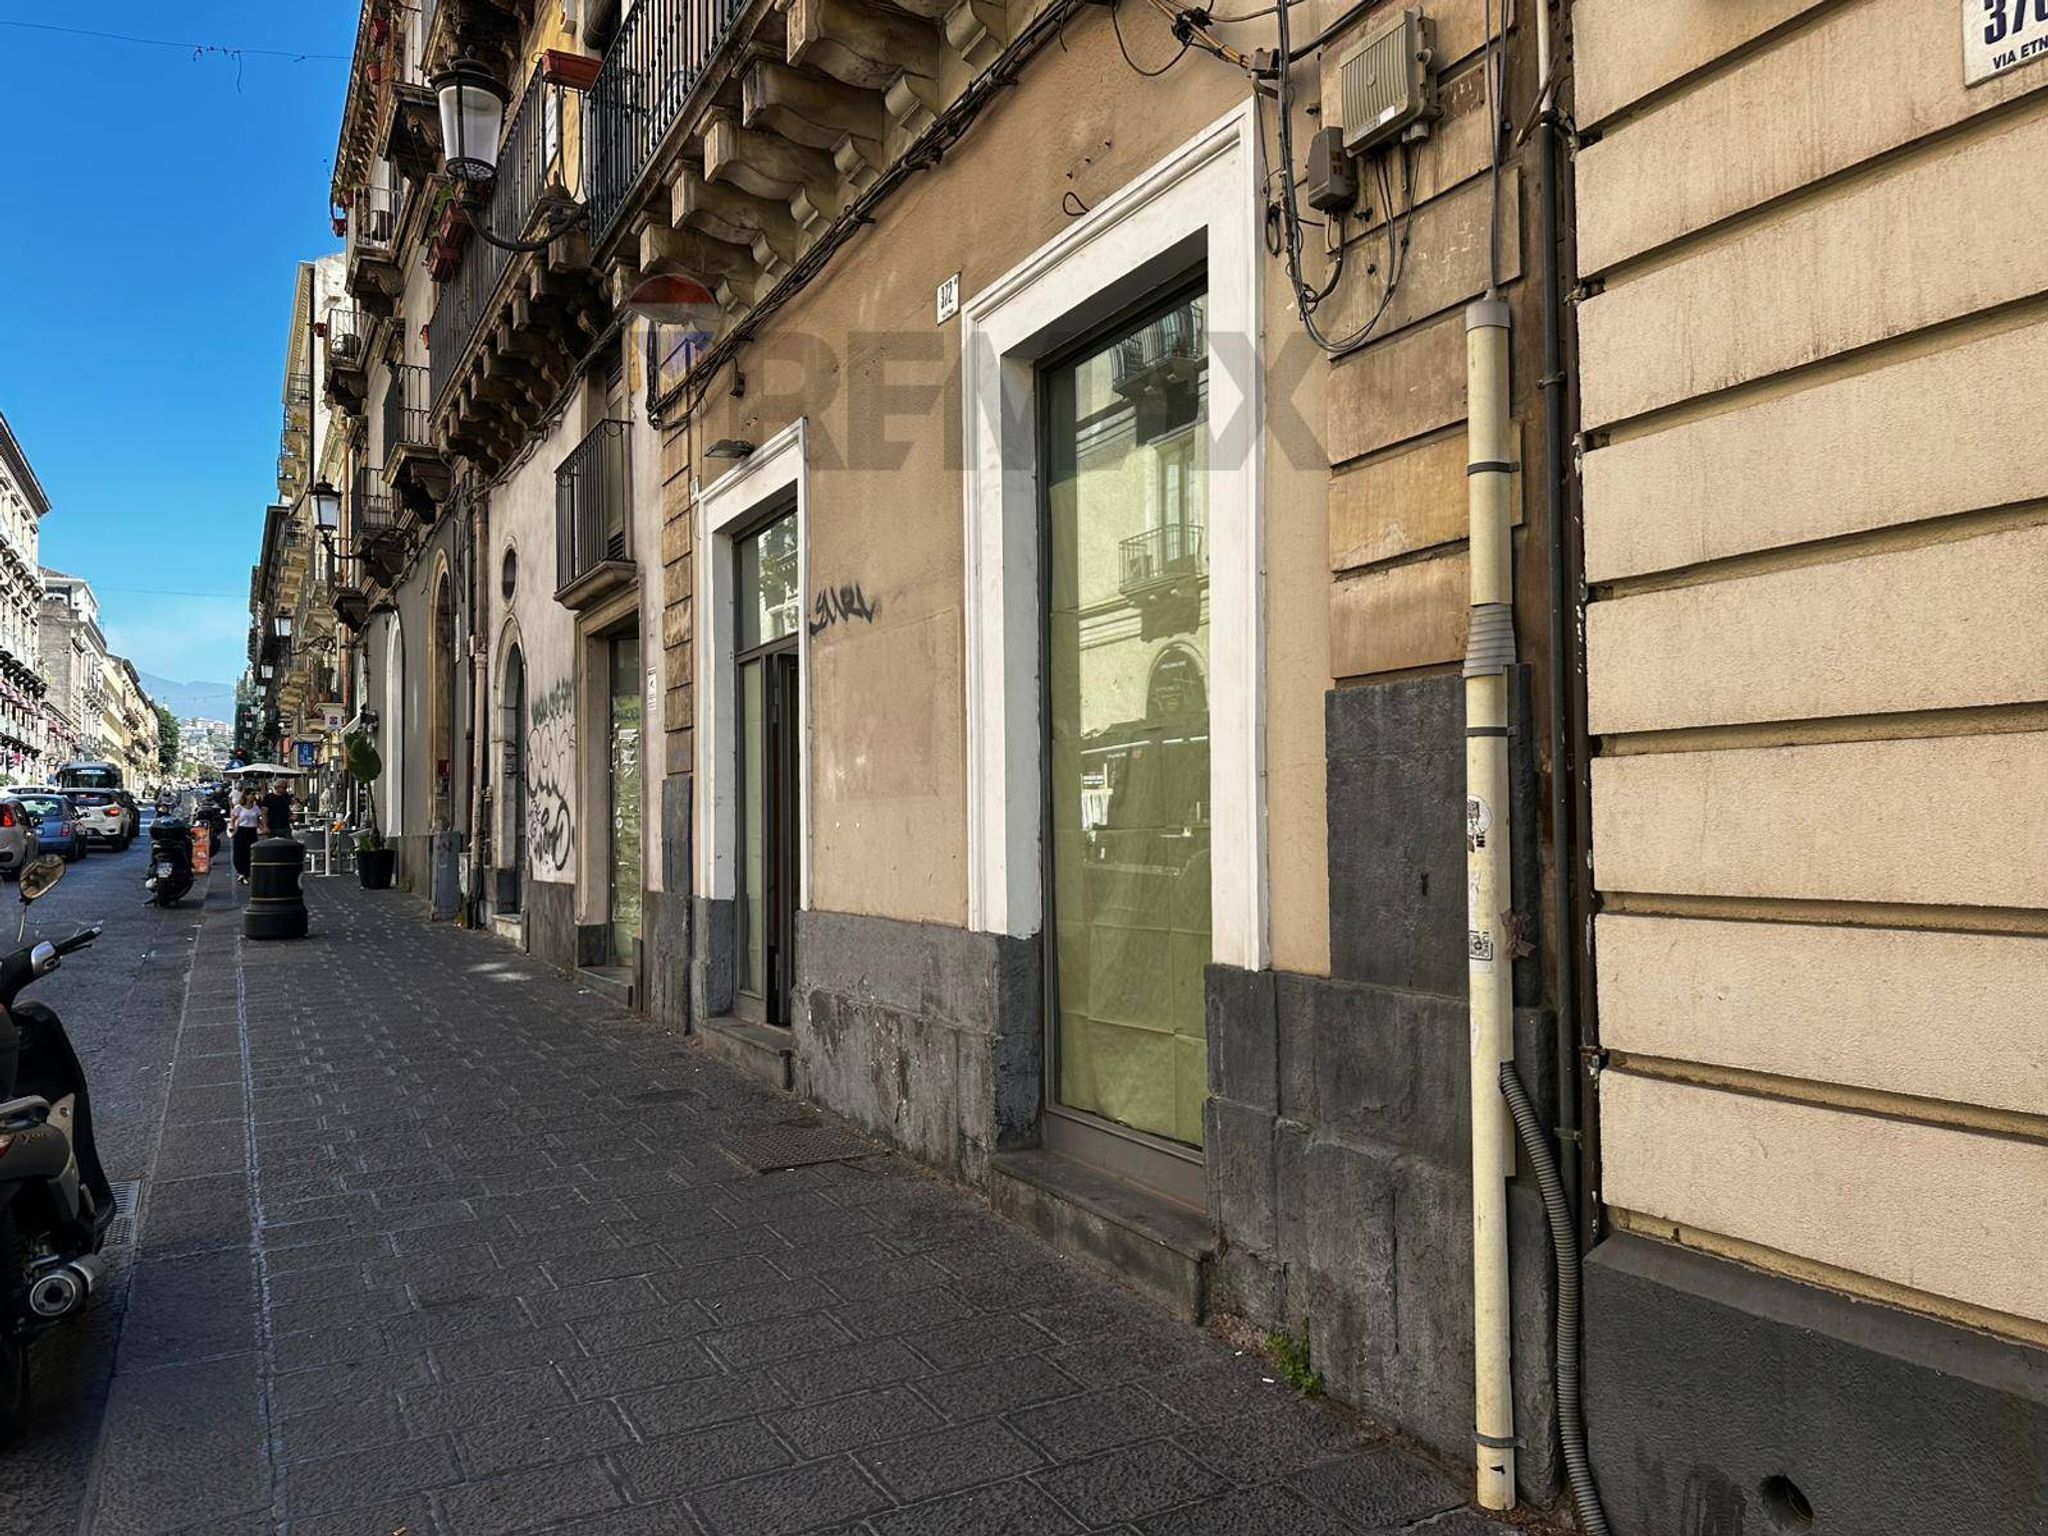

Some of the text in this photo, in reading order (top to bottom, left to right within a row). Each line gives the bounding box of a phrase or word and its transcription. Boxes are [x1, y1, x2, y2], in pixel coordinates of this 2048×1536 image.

[1984, 0, 2048, 45] 37
[1993, 35, 2048, 69] VIA ETN
